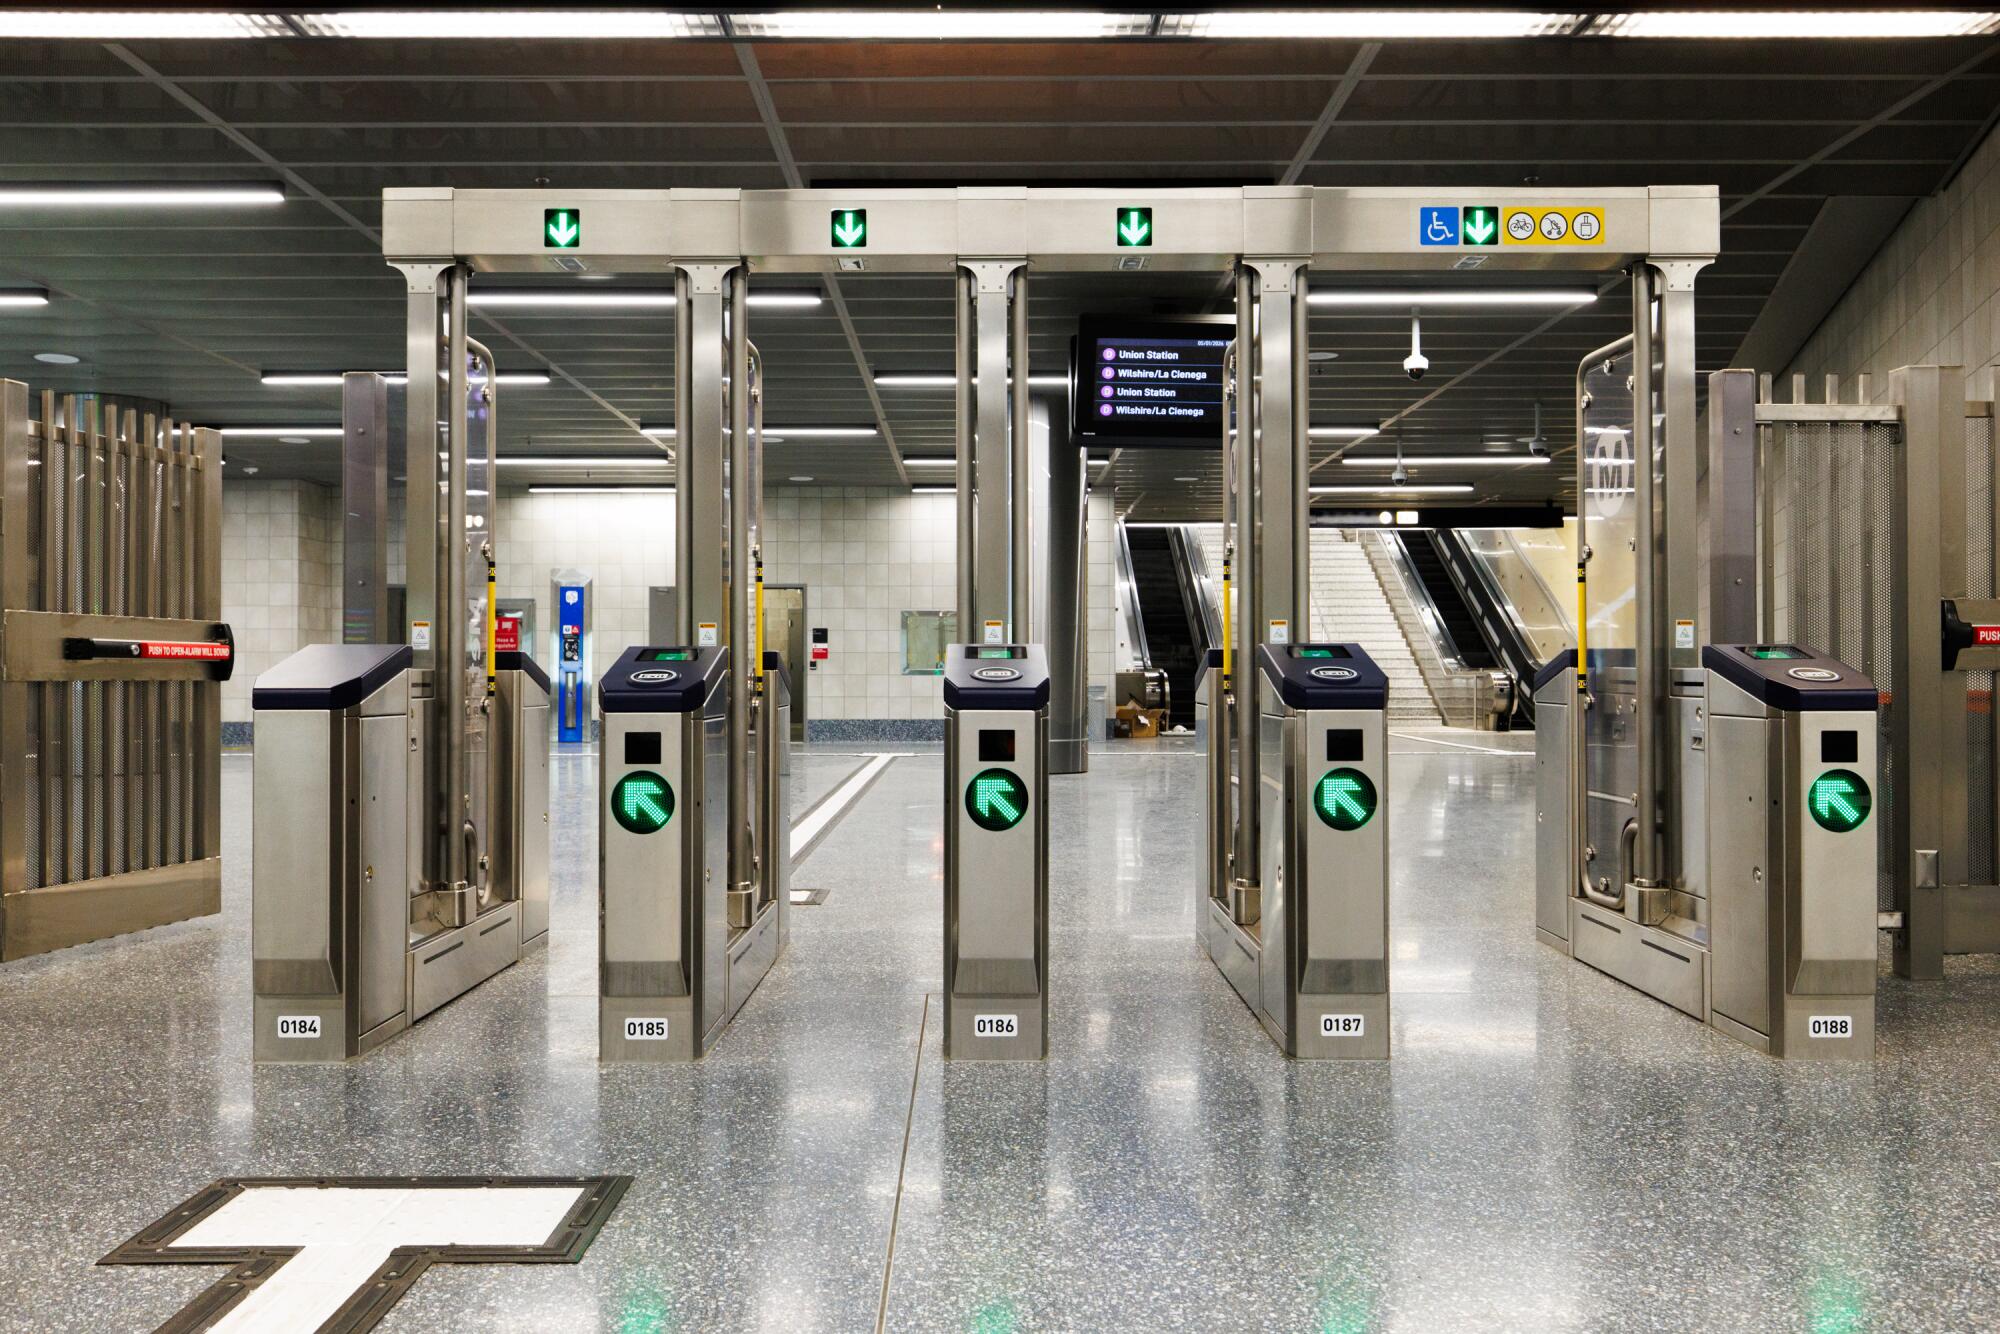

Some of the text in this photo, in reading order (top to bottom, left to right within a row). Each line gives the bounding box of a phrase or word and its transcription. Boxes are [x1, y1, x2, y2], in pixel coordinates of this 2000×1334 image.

[1119, 350, 1144, 359] Union
[1146, 350, 1178, 360] Station
[1118, 369, 1168, 379] Wilshire/La
[1171, 370, 1207, 380] Cienega
[1117, 387, 1142, 396] Union
[1144, 388, 1176, 397] Station
[1116, 406, 1166, 415] Wilshire/La
[1169, 407, 1203, 417] Cienega
[148, 646, 162, 655] PUSH
[163, 646, 171, 656] TO
[201, 647, 212, 656] WILL
[281, 1020, 317, 1034] 0184
[627, 1022, 665, 1036] 0185
[977, 1019, 1014, 1033] 0186
[1323, 1018, 1361, 1032] 0187
[1812, 1020, 1849, 1034] 0188
